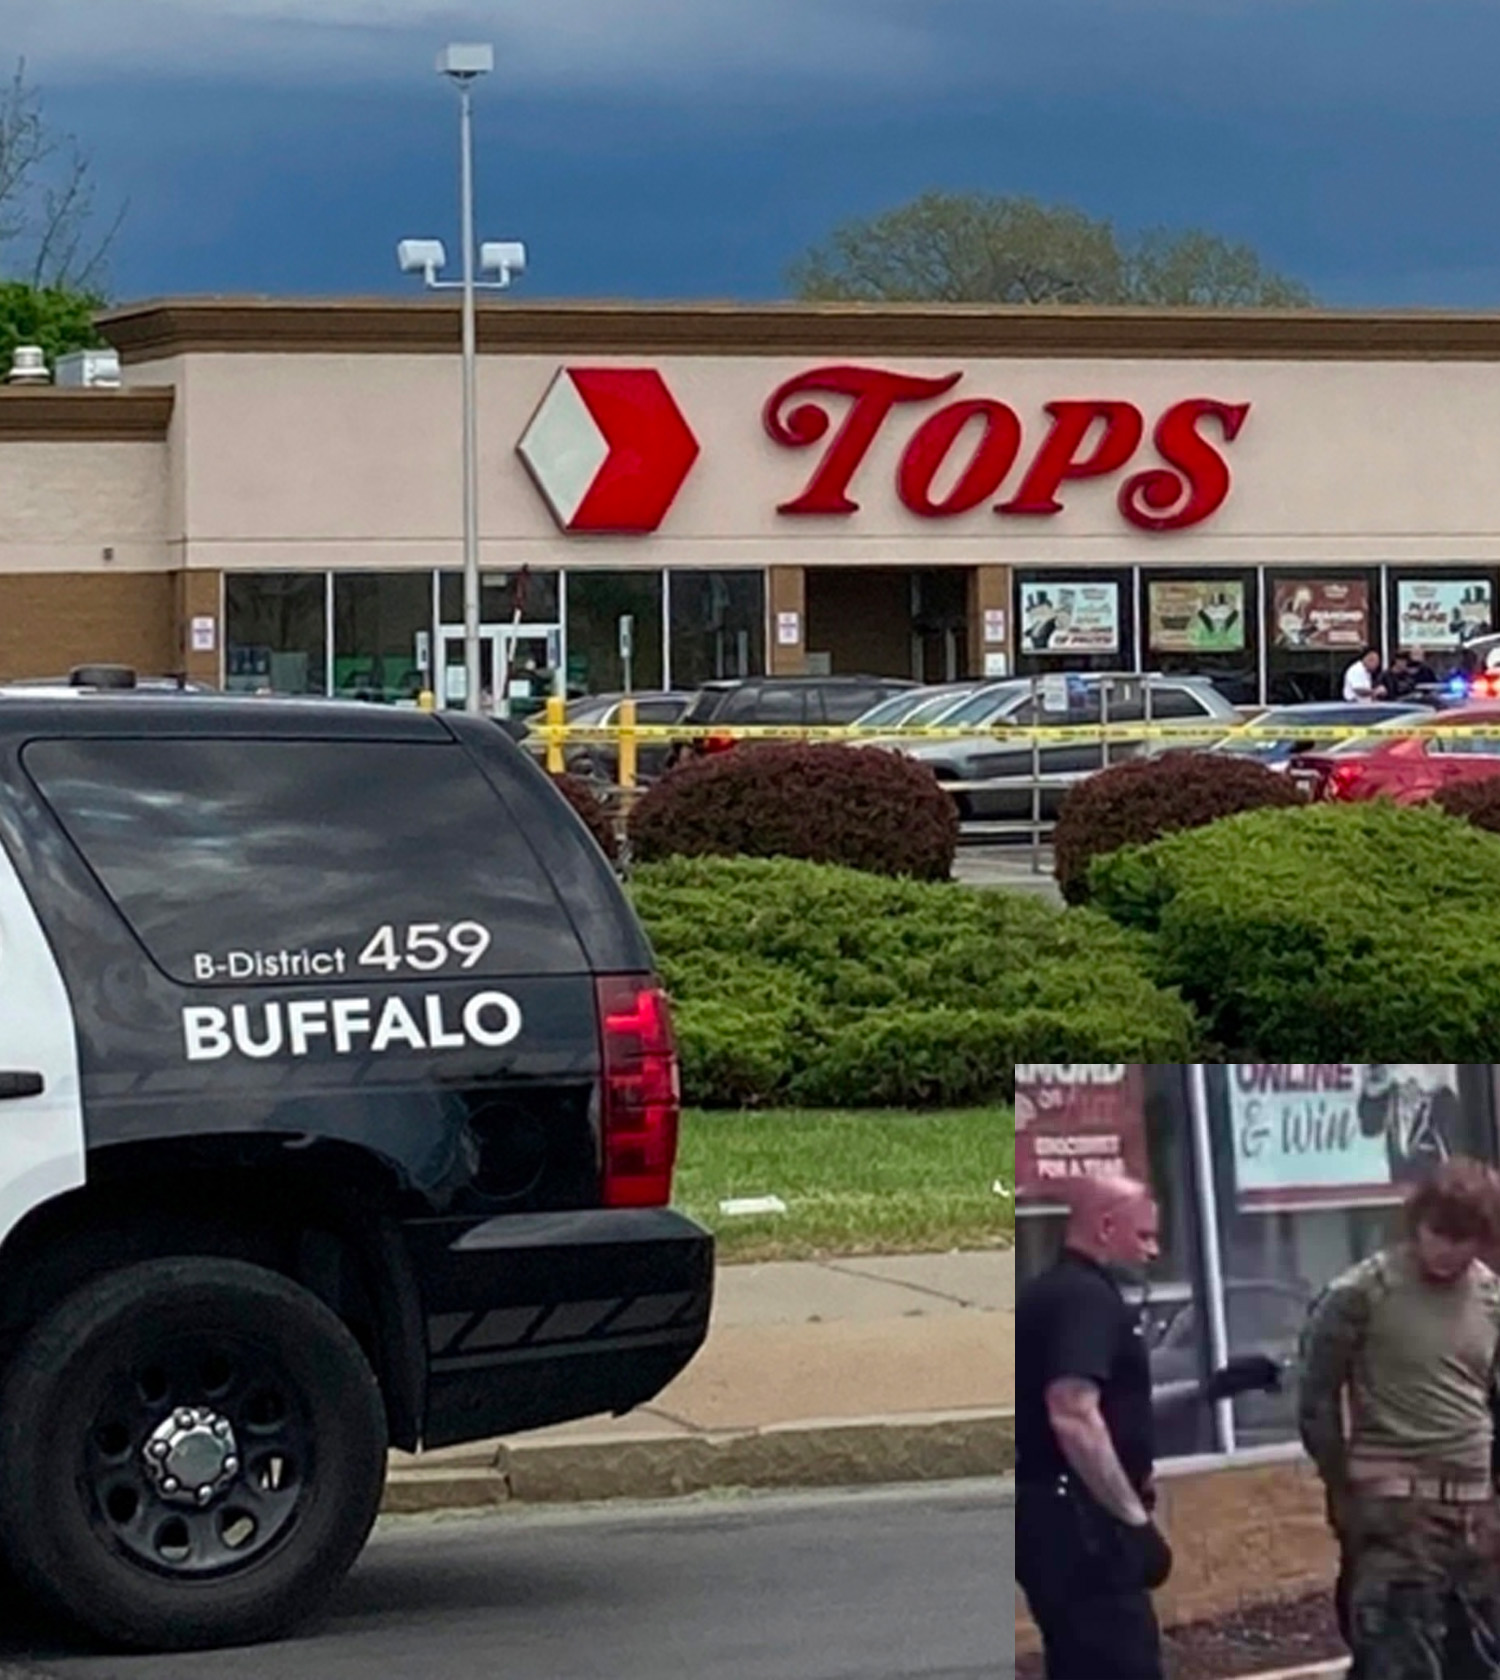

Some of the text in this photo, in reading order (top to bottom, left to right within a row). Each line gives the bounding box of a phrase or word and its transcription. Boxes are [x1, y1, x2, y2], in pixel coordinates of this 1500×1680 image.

[763, 365, 1251, 532] TOPS
[194, 920, 490, 980] B-District 459
[182, 991, 522, 1060] BUFFALO
[1236, 1064, 1353, 1093] ONLINE
